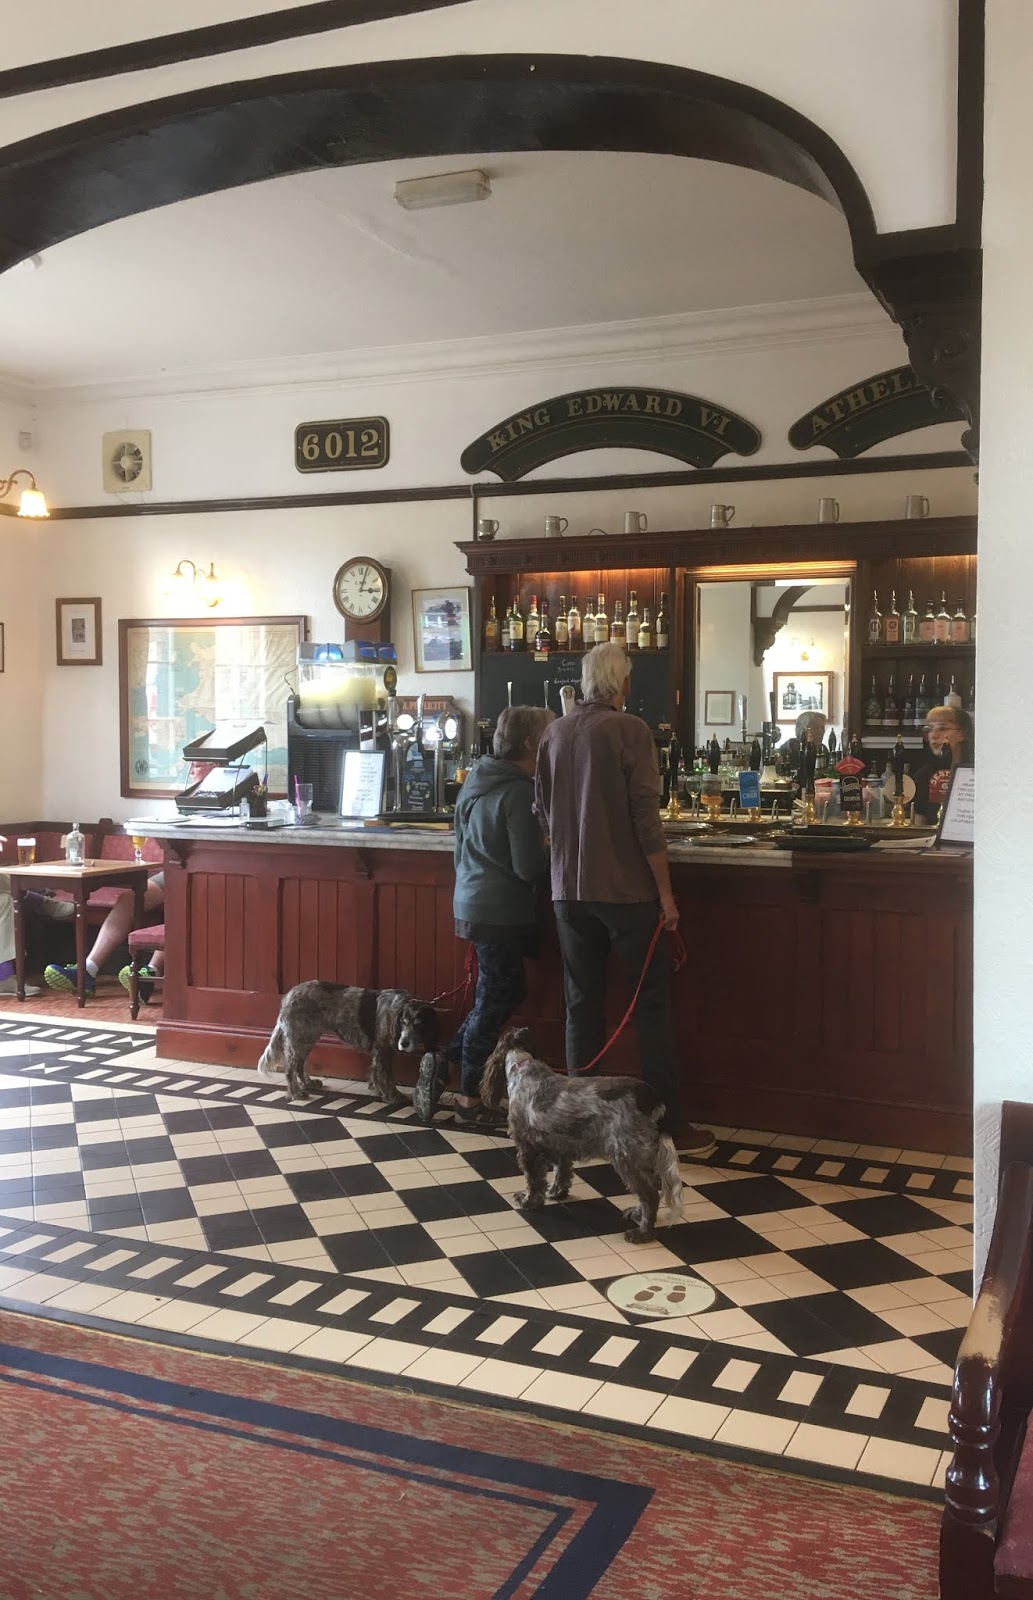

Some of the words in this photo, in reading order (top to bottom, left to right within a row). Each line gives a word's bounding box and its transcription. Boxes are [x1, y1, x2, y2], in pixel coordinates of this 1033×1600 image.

[302, 429, 380, 461] 6012
[486, 407, 551, 453] KING
[567, 392, 683, 418] EDWARD
[699, 406, 732, 436] VI
